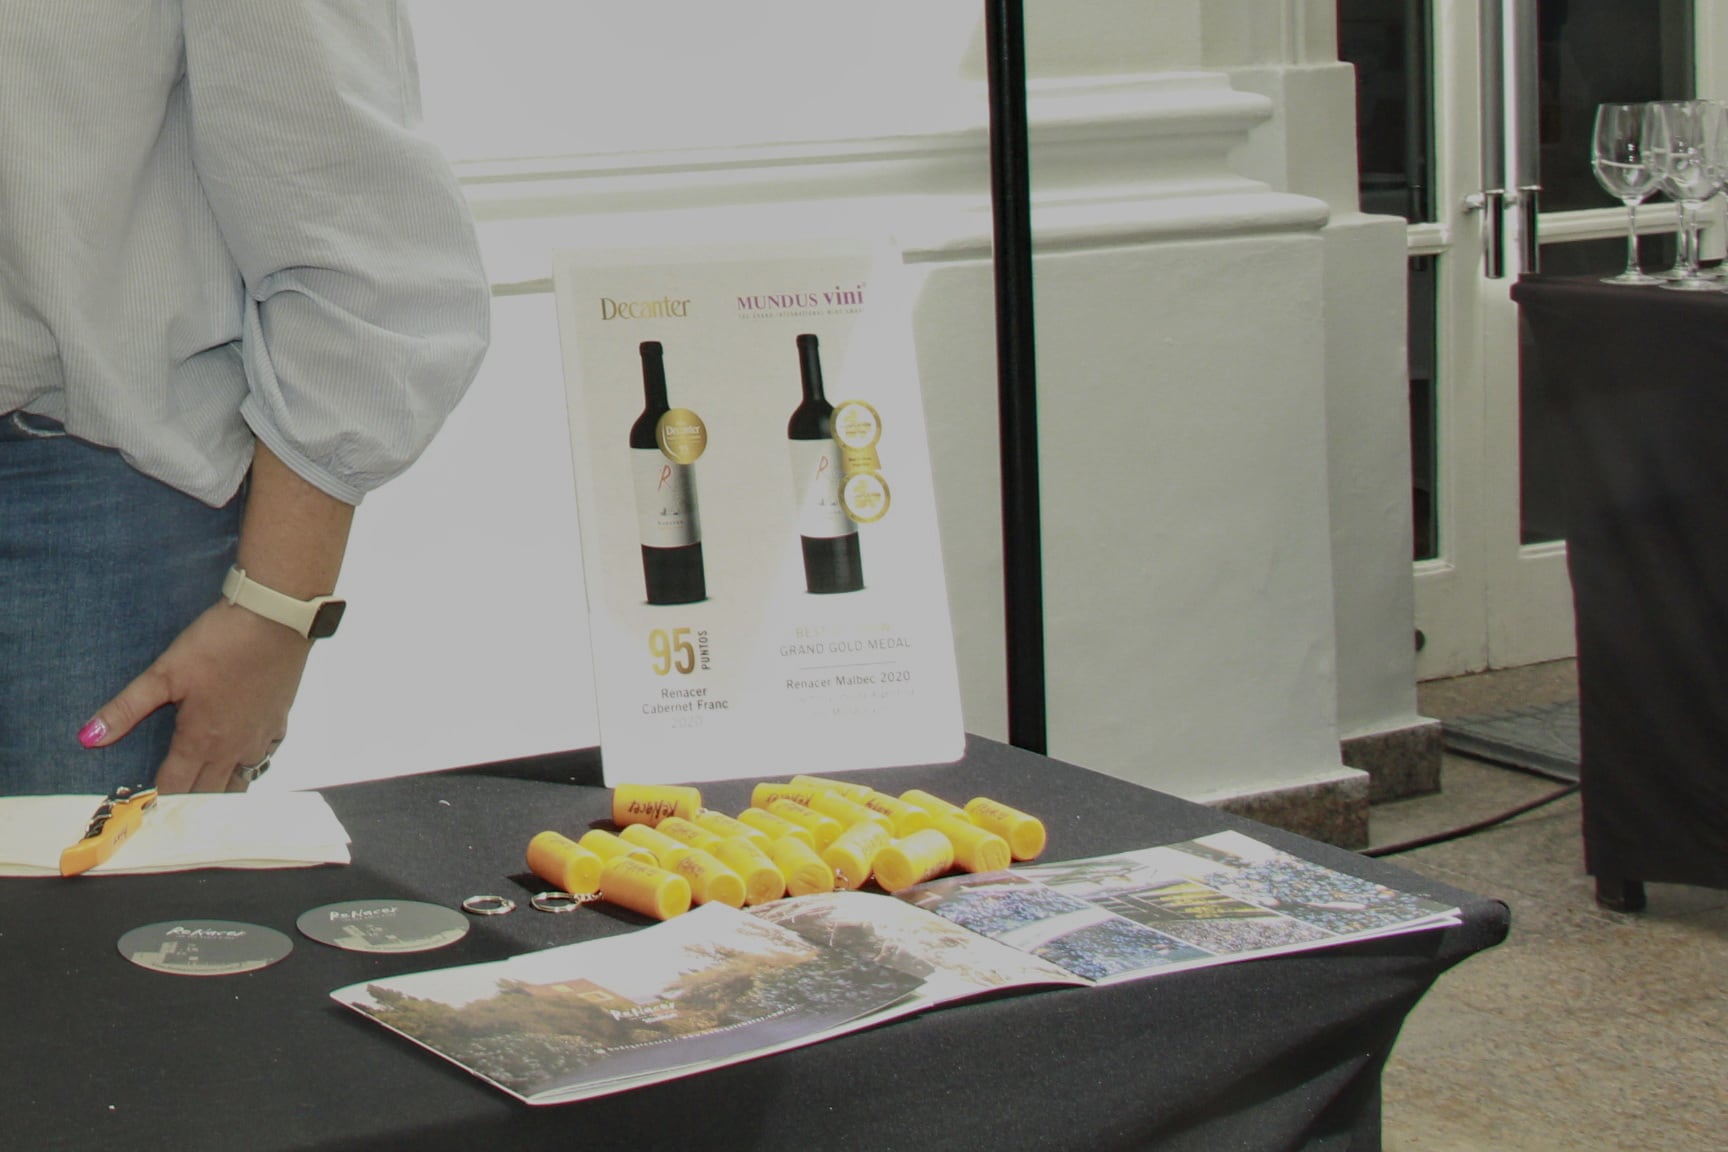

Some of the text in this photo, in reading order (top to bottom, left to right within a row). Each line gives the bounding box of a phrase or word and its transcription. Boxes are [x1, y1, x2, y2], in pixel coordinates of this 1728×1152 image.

[599, 294, 691, 321] Decanter
[736, 292, 819, 311] MUNDUS
[647, 627, 710, 677] 95 PUNTOS
[779, 636, 912, 657] GRAND GOLD MEDAL
[786, 669, 911, 690] Renacer Malbec 2020
[660, 687, 707, 700] Renacer
[642, 698, 729, 715] Cabernet Franc
